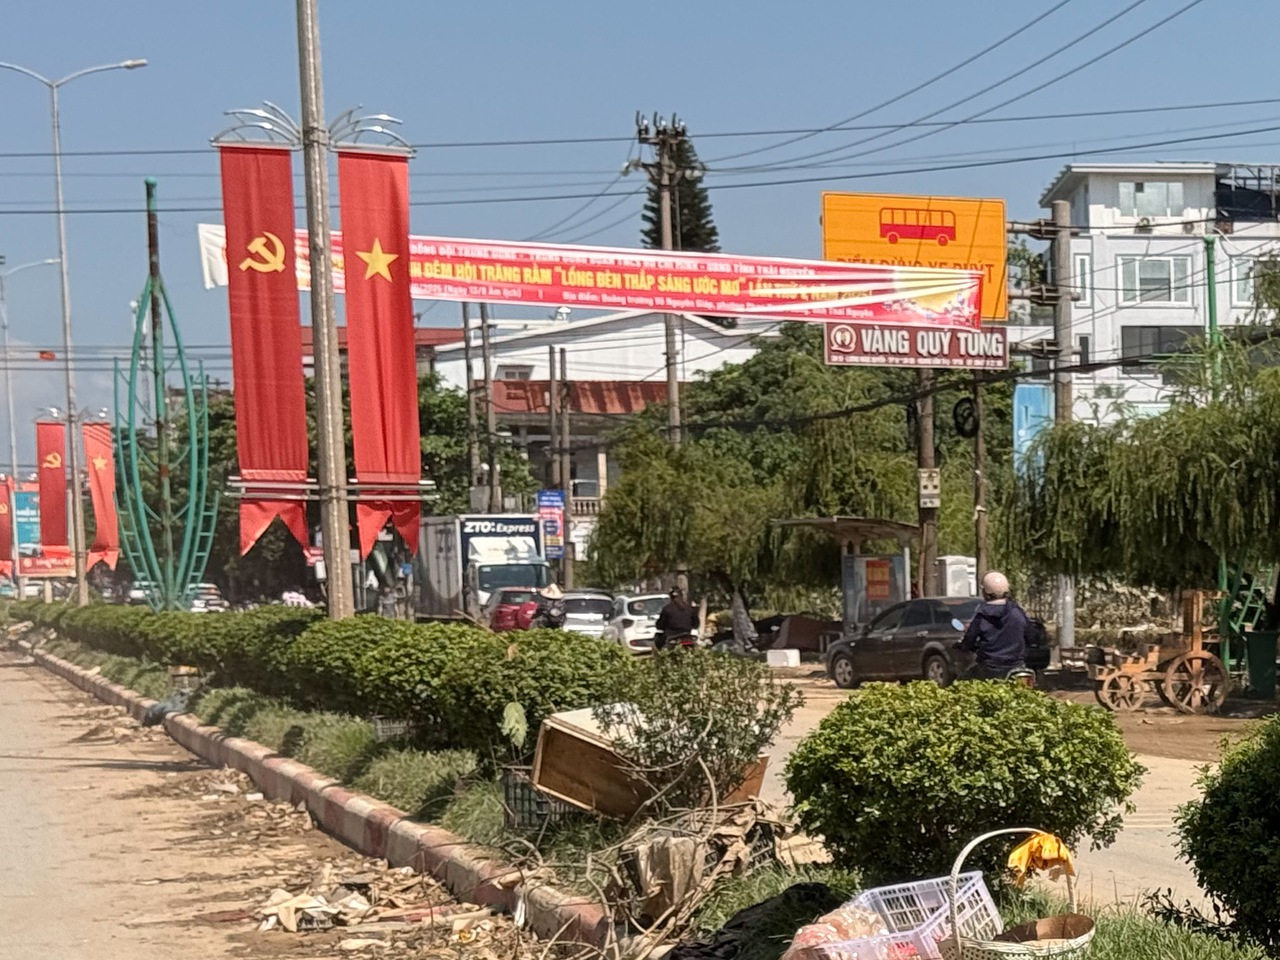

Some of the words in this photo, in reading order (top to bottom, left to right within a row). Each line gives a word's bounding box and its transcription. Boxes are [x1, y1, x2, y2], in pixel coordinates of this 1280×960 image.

[657, 273, 692, 294] SÁNG
[860, 326, 910, 355] VÀNG
[916, 328, 952, 357] QUÝ
[496, 523, 536, 535] Express
